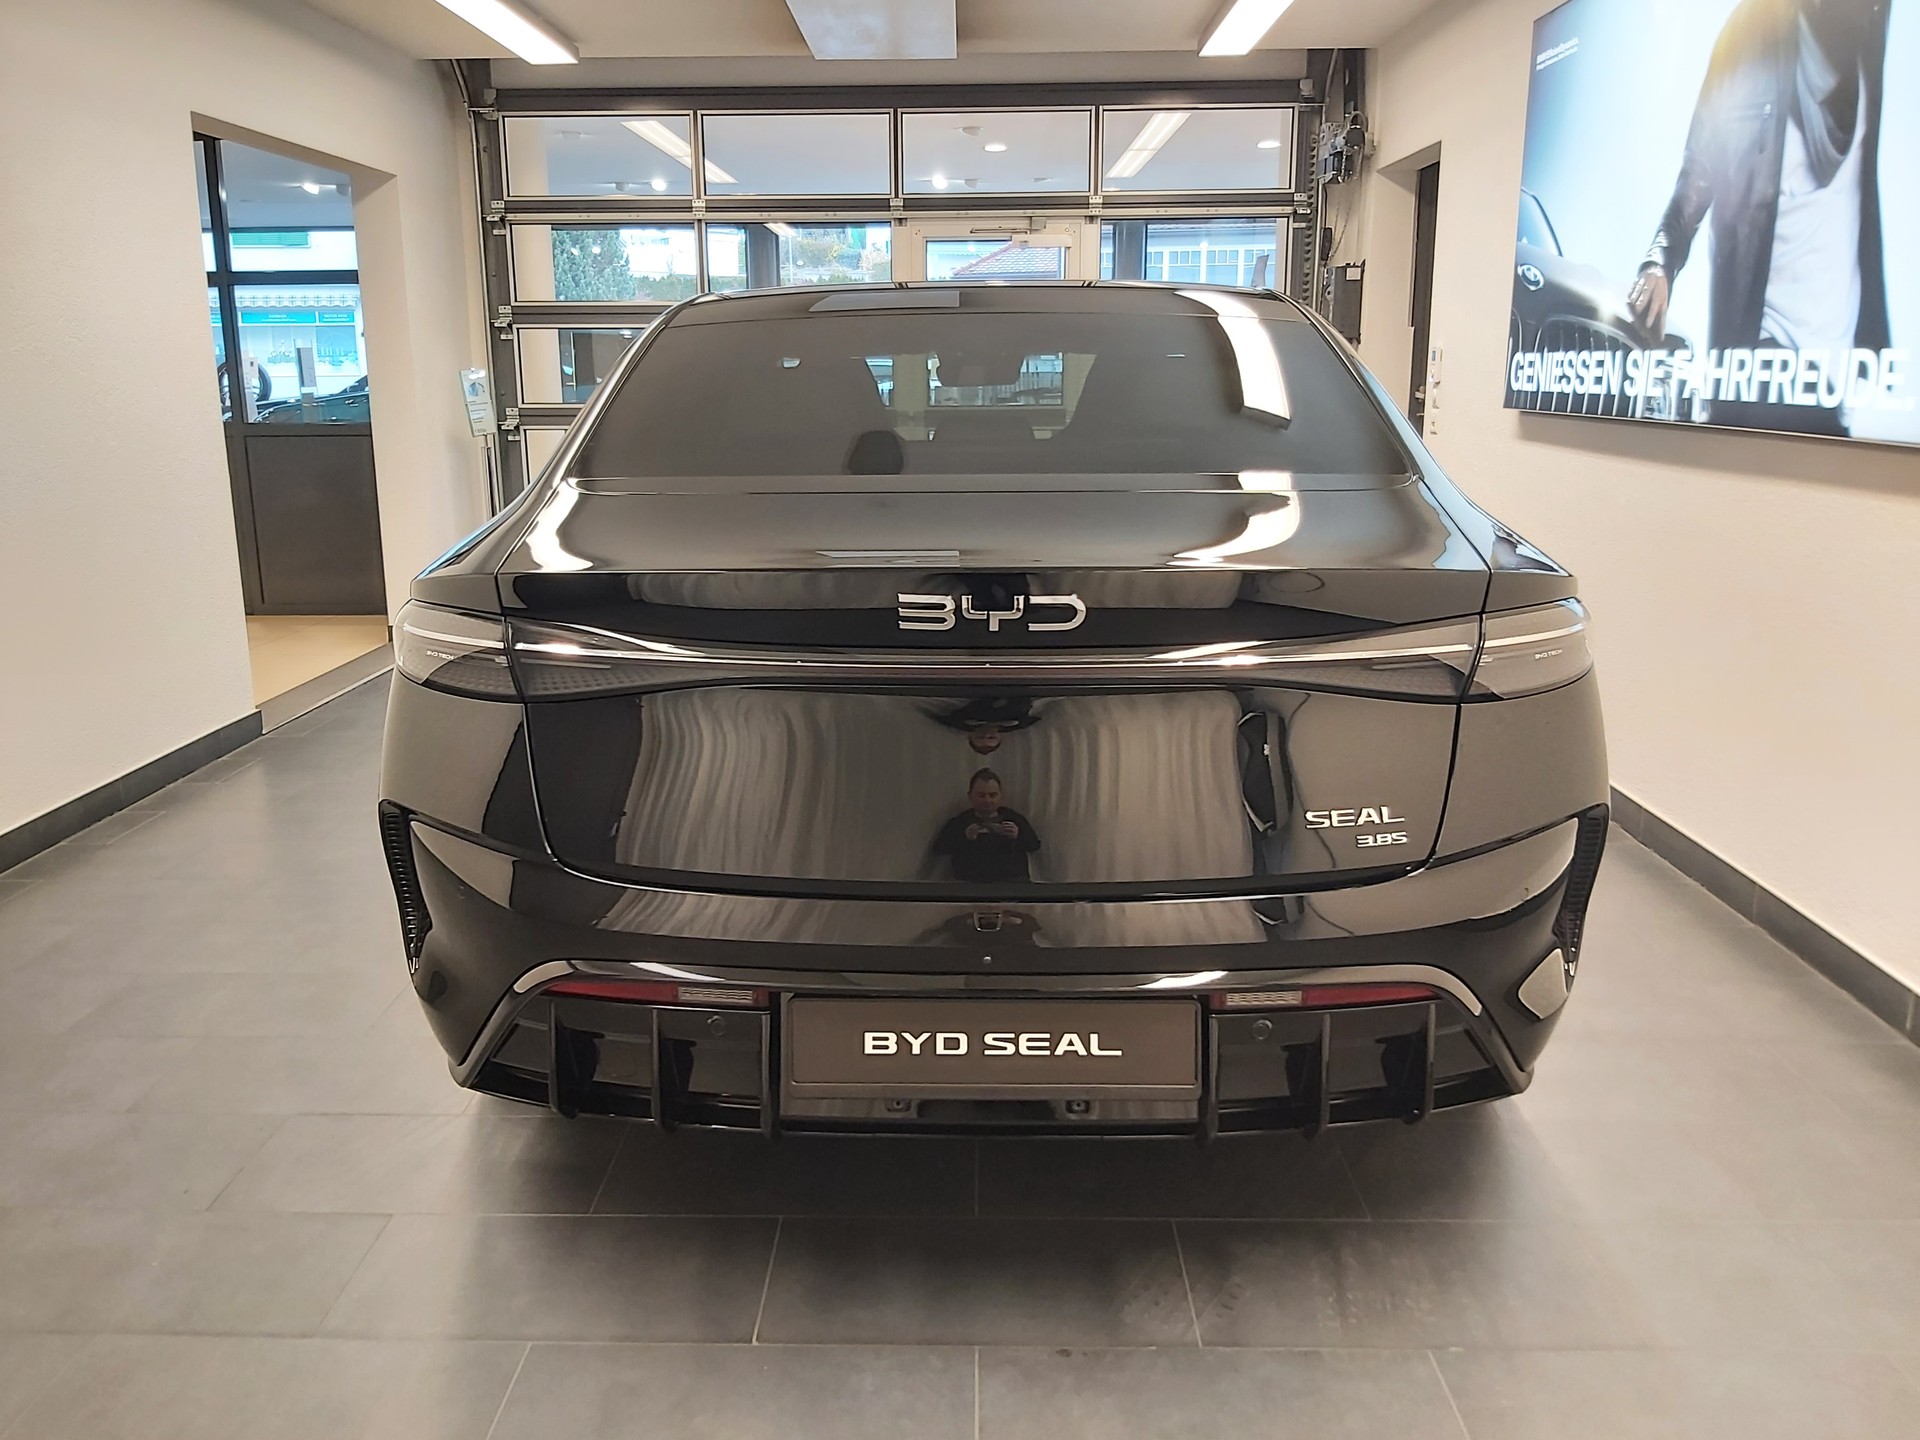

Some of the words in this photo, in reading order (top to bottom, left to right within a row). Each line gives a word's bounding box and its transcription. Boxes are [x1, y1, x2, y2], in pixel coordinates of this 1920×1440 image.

[1510, 351, 1622, 395] GENIESSEN
[1624, 349, 1669, 397] SIE
[898, 593, 1087, 632] BYD
[1305, 806, 1405, 829] SEAL
[863, 1031, 969, 1056] BYD
[983, 1032, 1124, 1057] SEAL
